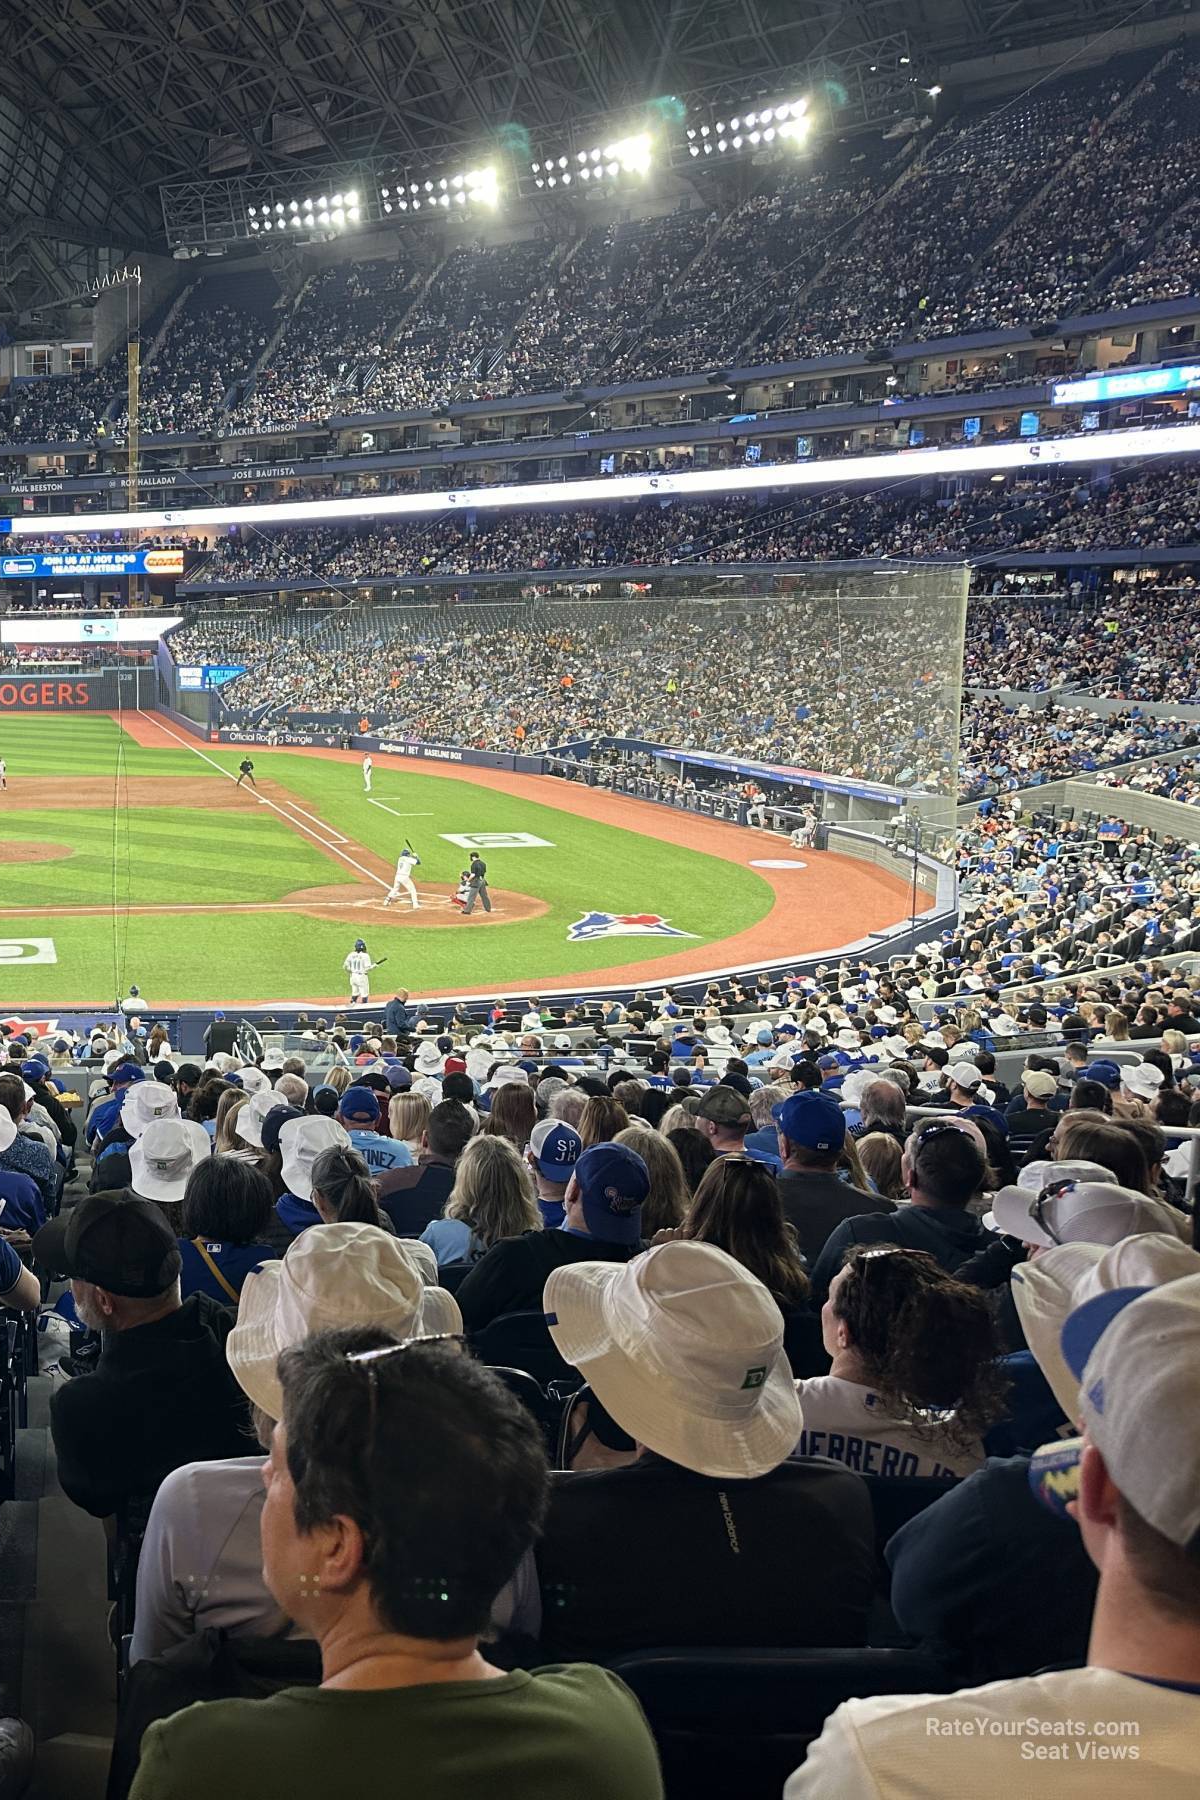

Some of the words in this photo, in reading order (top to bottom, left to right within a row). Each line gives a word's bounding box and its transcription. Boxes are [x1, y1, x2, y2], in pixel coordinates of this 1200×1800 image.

[228, 426, 254, 437] JACKIE
[256, 423, 297, 434] ROBINSON
[256, 468, 295, 478] BAUTISTA
[120, 479, 136, 487] ROY
[137, 477, 176, 487] HALLADAY
[11, 485, 29, 493] PAUL
[30, 483, 63, 492] BEESTON
[42, 557, 63, 565] JOIN
[65, 556, 77, 564] US
[80, 556, 92, 564] AT
[94, 555, 112, 563] HOT
[115, 555, 136, 563] DOG
[229, 731, 255, 742] Official
[284, 733, 313, 745] Shingle
[424, 748, 449, 759] BASELINE
[450, 750, 462, 760] BOX
